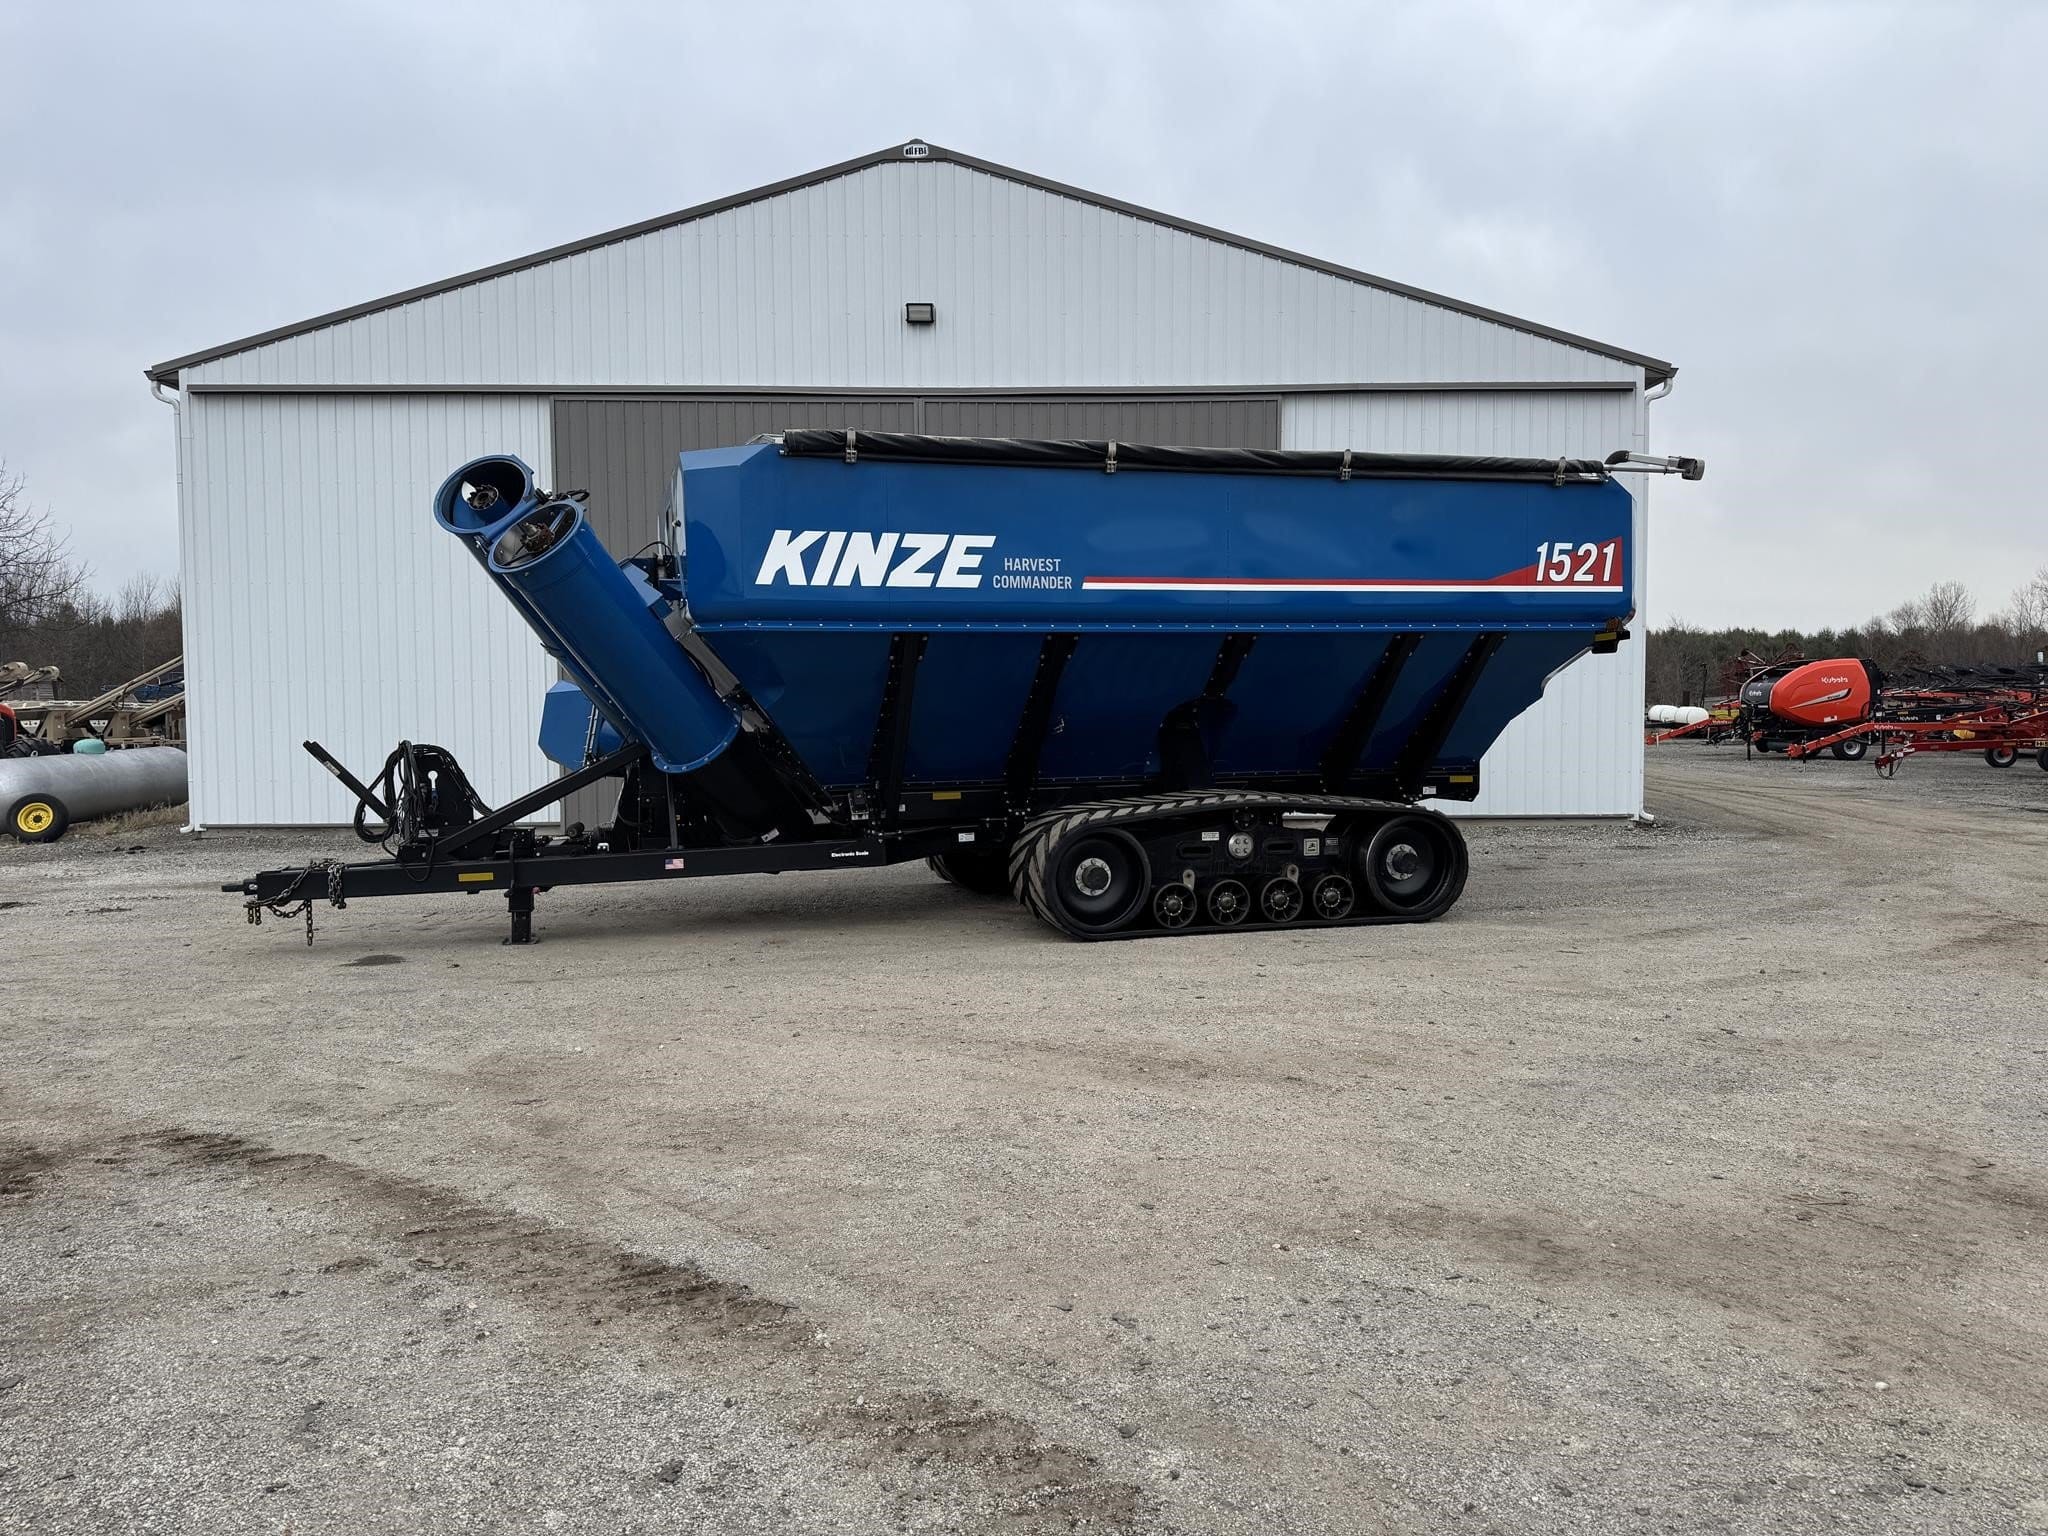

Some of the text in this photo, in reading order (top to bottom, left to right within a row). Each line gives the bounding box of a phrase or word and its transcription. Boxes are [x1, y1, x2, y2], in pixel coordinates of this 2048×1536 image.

[754, 529, 997, 589] KINZE
[1004, 557, 1061, 572] HARVEST
[1536, 541, 1616, 582] 1521
[992, 574, 1073, 590] COMMANDER
[1821, 676, 1849, 684] Kubota
